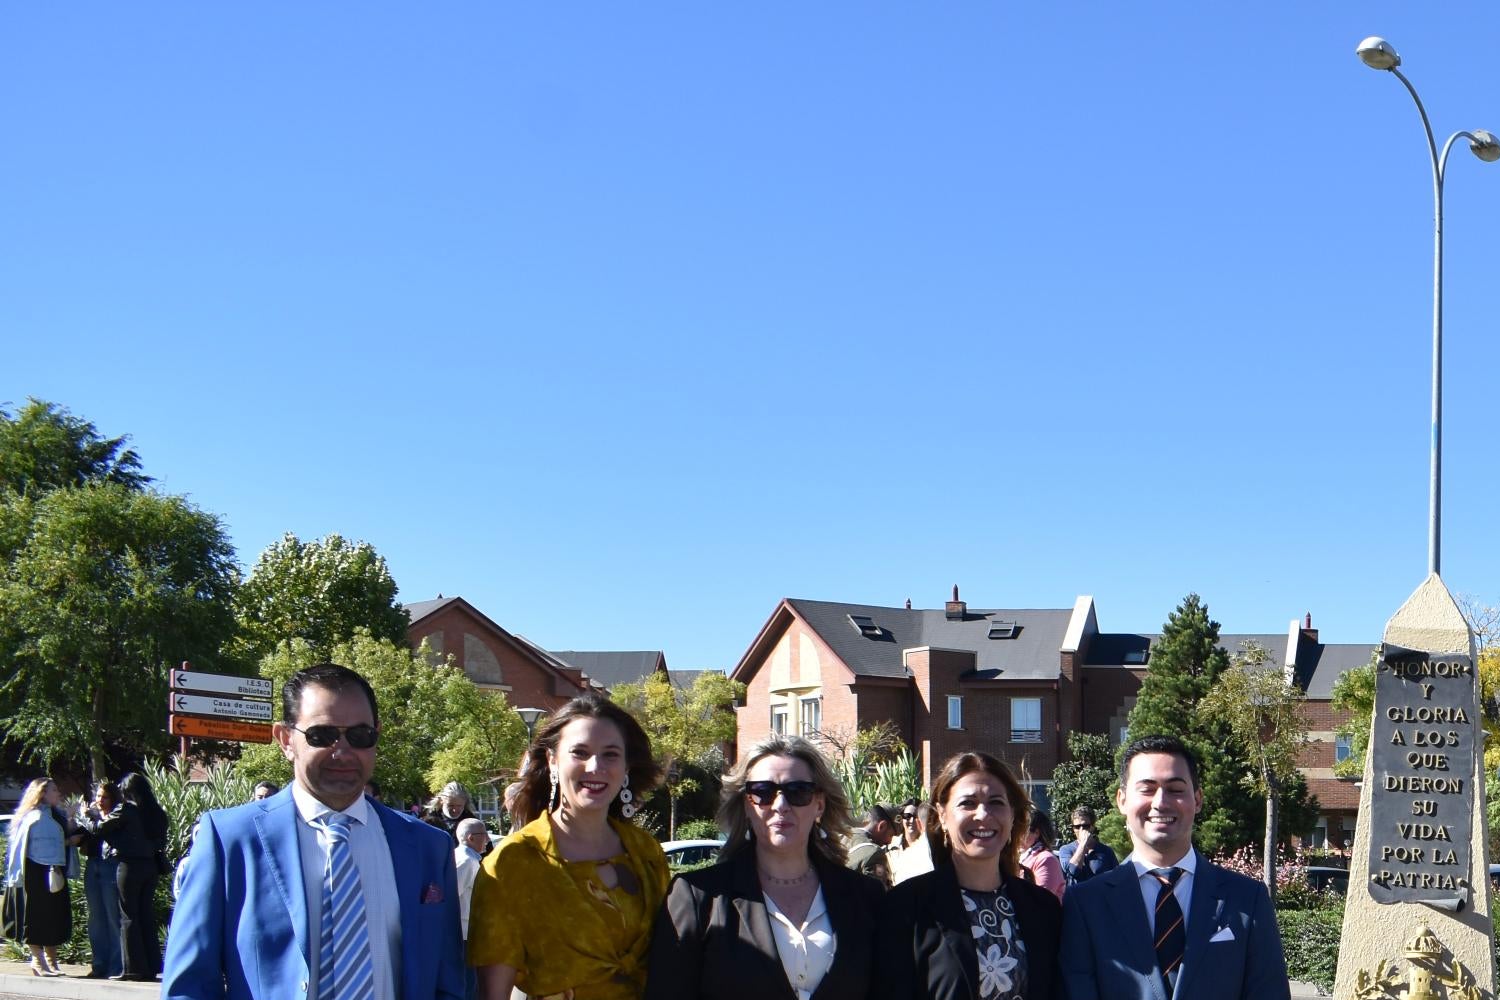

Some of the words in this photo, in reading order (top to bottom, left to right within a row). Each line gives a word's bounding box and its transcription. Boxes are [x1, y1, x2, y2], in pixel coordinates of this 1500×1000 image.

[1393, 661, 1462, 677] HONOR
[239, 686, 270, 695] Biblioteca
[1421, 683, 1434, 699] Y
[245, 703, 270, 711] cultura
[1386, 706, 1468, 722] GLORIA
[1391, 729, 1404, 744] A
[1413, 730, 1459, 745] LOS
[1407, 751, 1448, 769] QUE
[1384, 775, 1461, 793] DIERON
[1411, 800, 1436, 815] SU
[1398, 822, 1449, 840] VIDA
[1381, 846, 1422, 862] POR
[1432, 848, 1458, 865] LA
[1380, 871, 1456, 889] PATRIA
